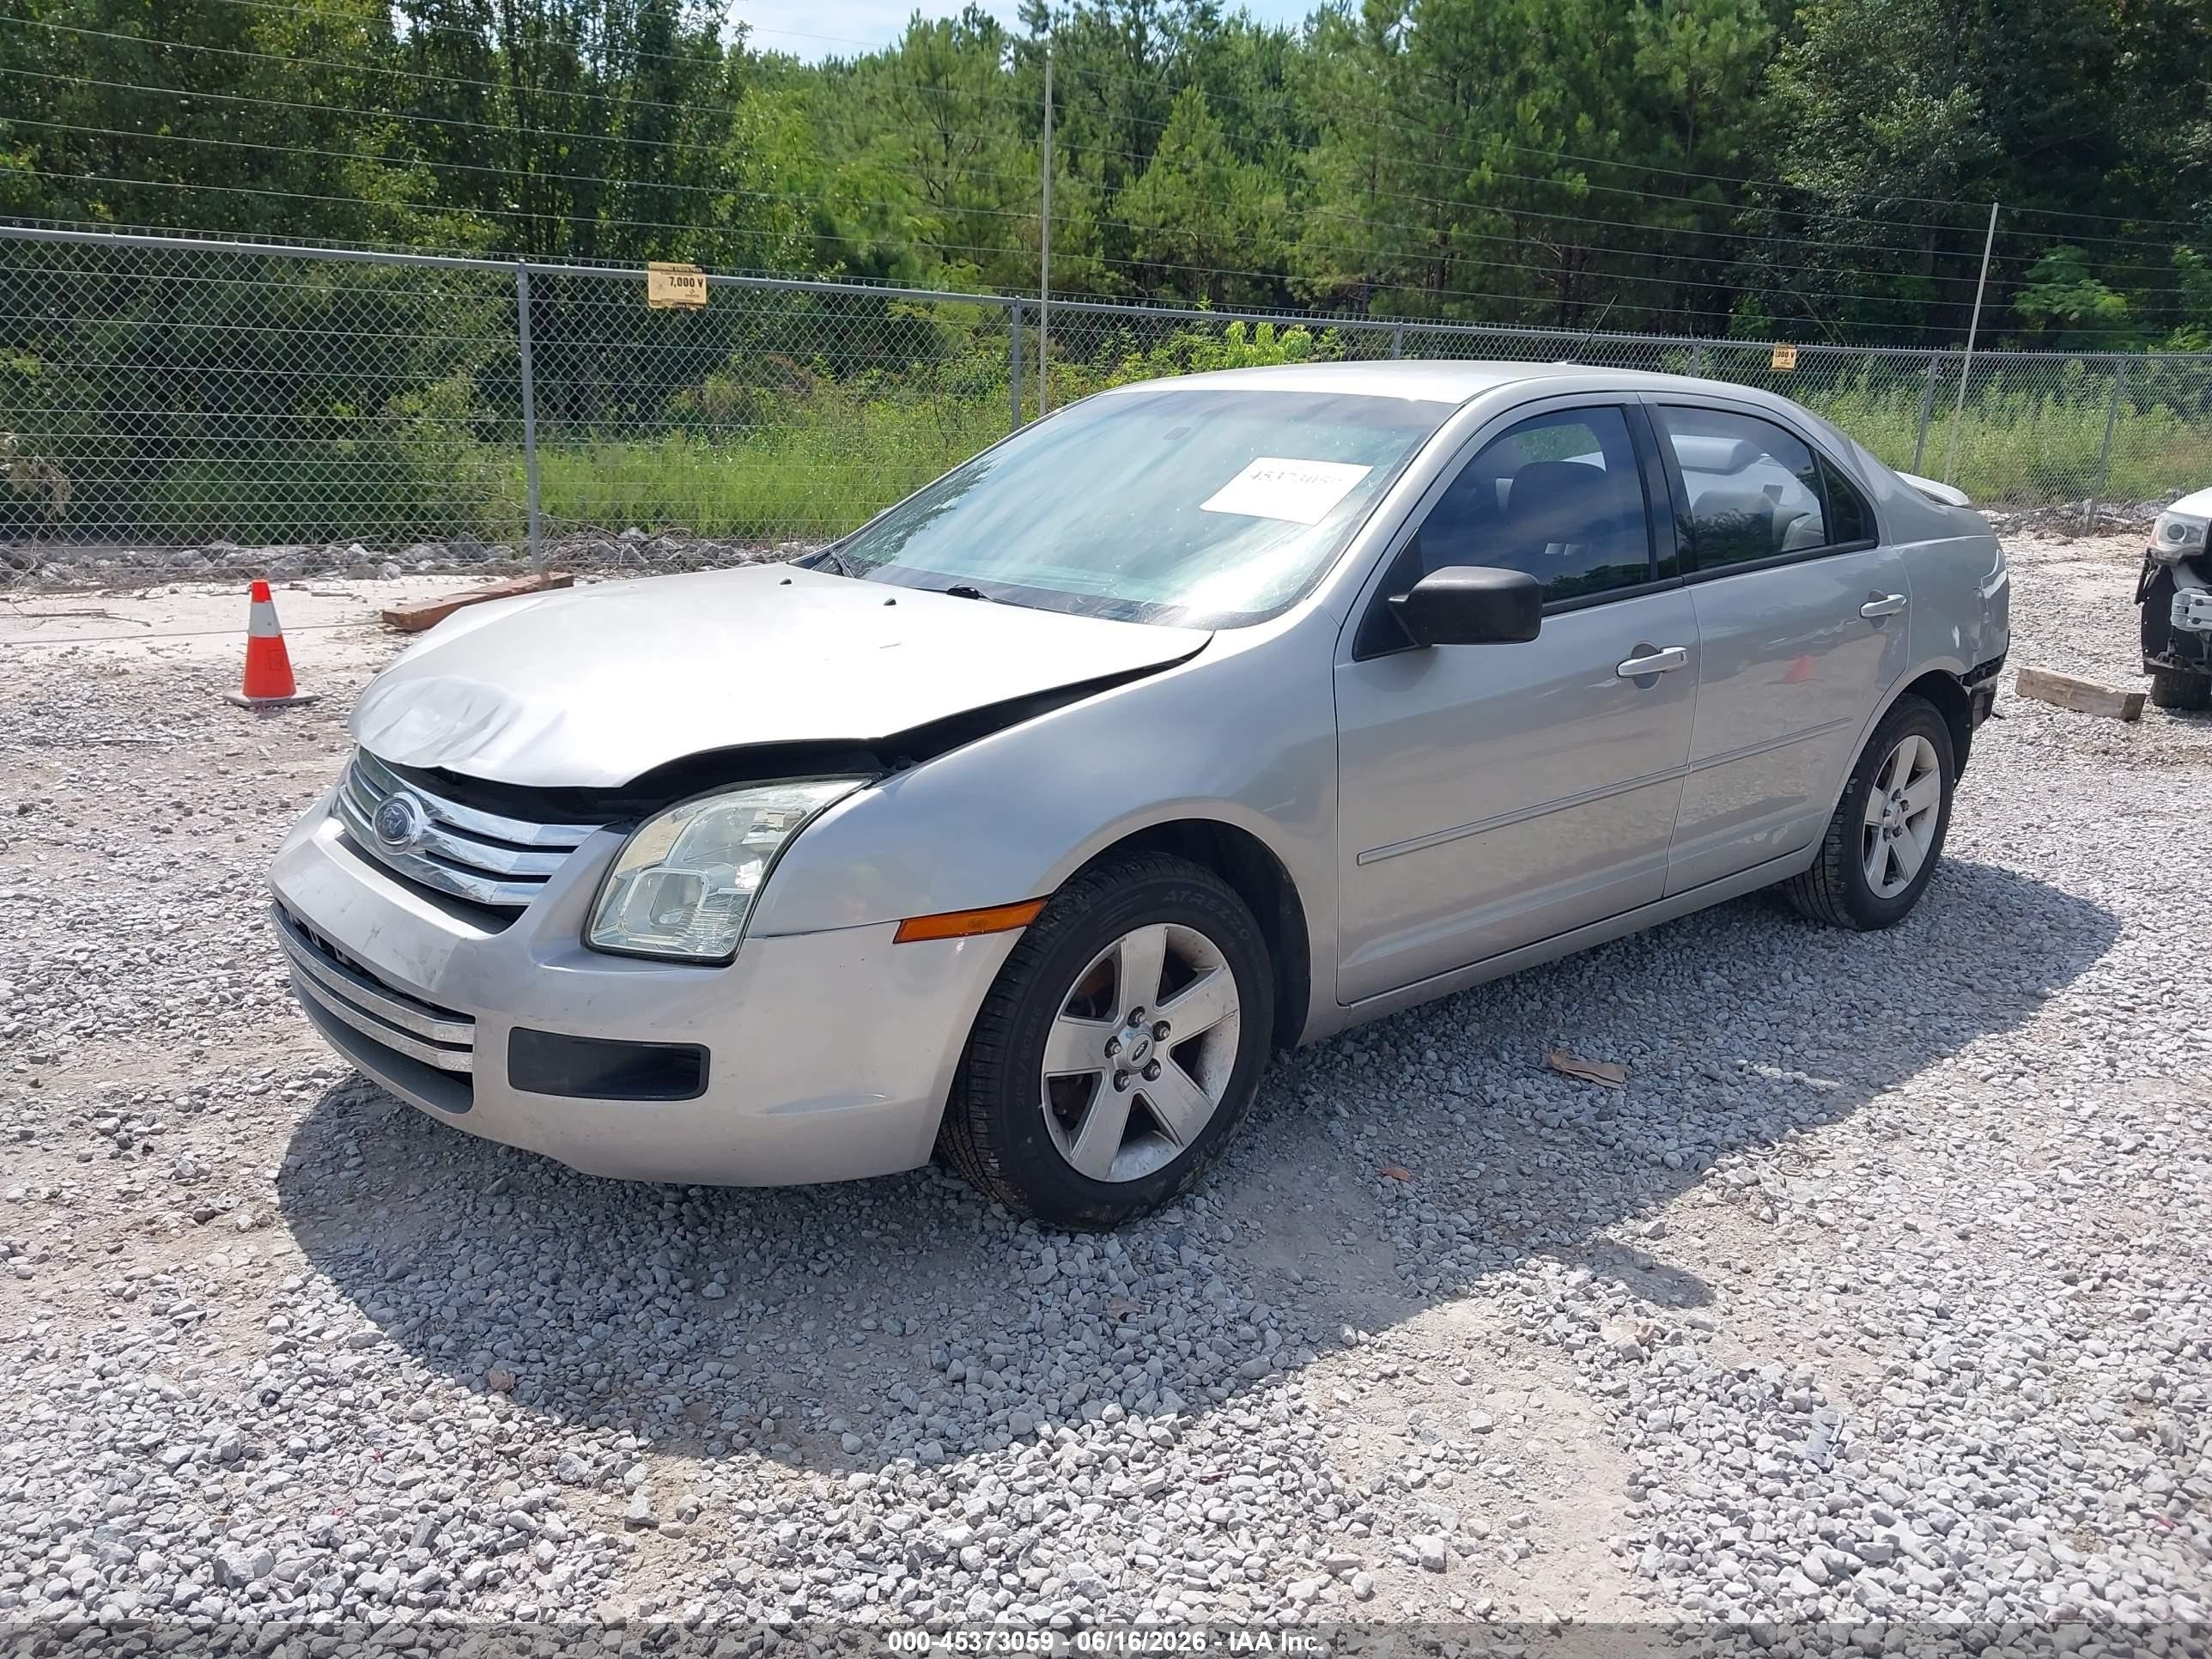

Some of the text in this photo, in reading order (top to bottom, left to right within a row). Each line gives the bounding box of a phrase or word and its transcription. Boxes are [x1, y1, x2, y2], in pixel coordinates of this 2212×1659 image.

[669, 276, 703, 288] 7,000 V
[380, 807, 403, 834] Ford
[1161, 890, 1251, 941] ATREZZO
